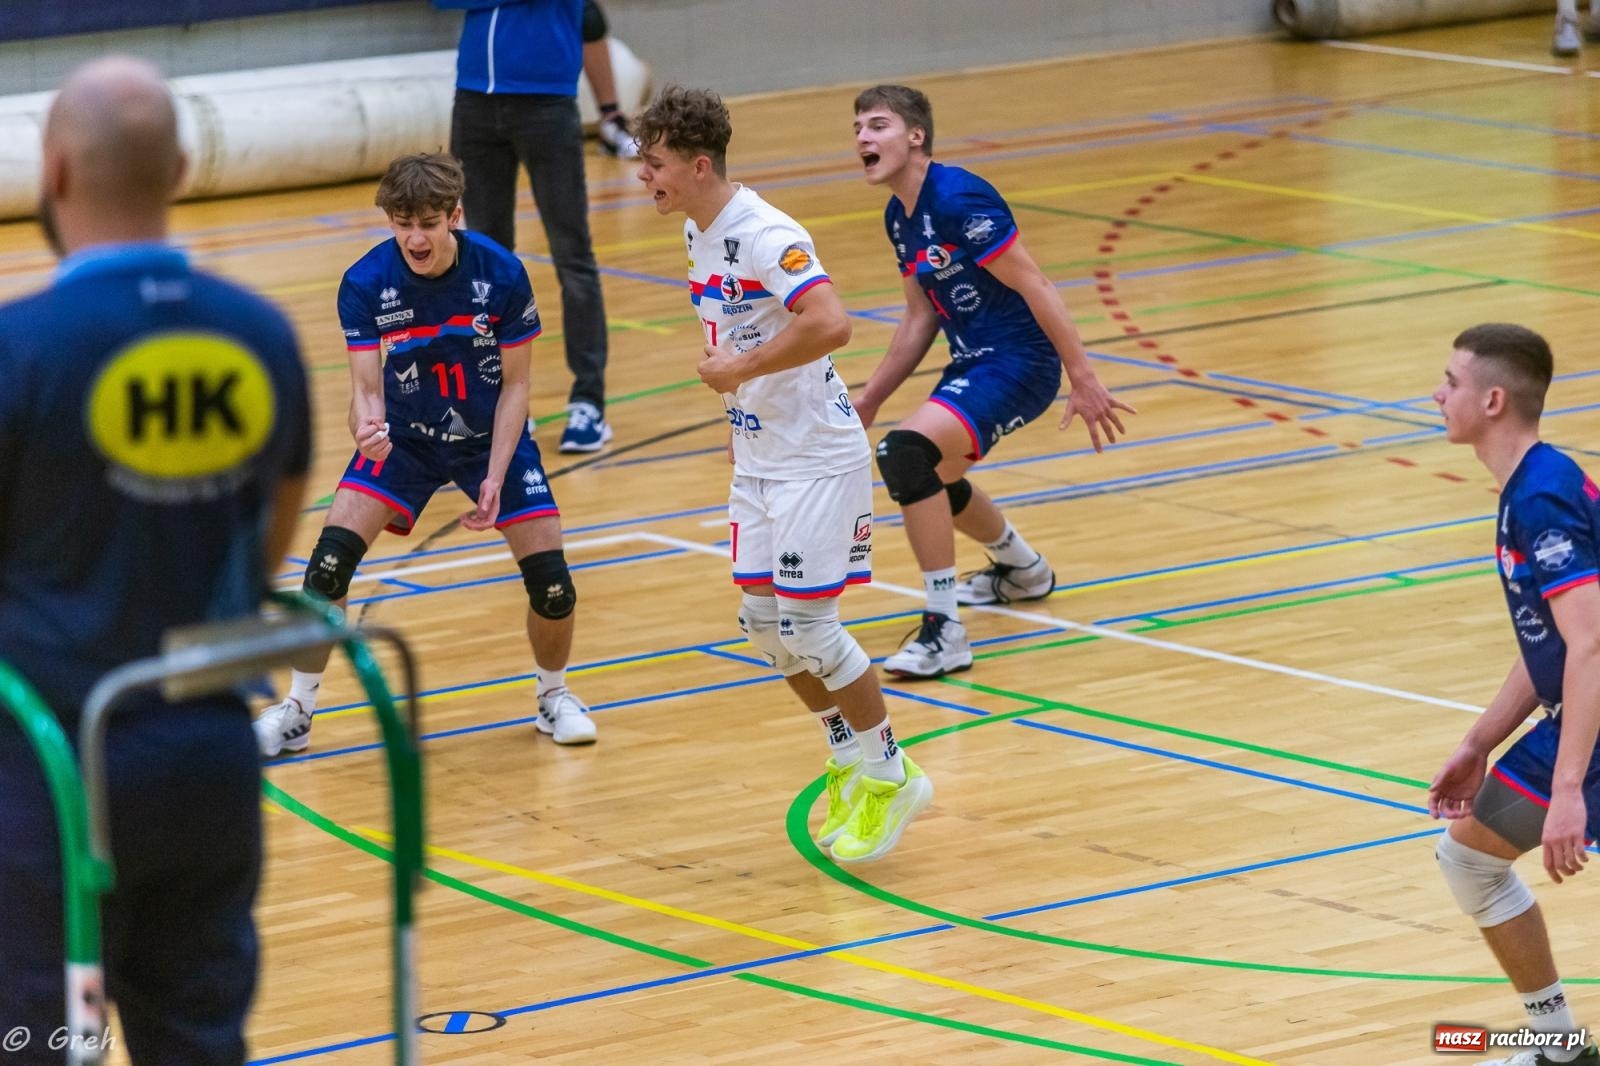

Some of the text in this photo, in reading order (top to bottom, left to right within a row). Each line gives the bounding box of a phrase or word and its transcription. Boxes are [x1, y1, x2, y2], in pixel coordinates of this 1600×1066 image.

[431, 362, 468, 400] 11
[126, 368, 247, 446] HK
[525, 485, 548, 495] errea
[780, 569, 803, 579] errea
[827, 712, 848, 744] MKS
[885, 726, 898, 757] MKS
[1524, 992, 1565, 1010] MKS
